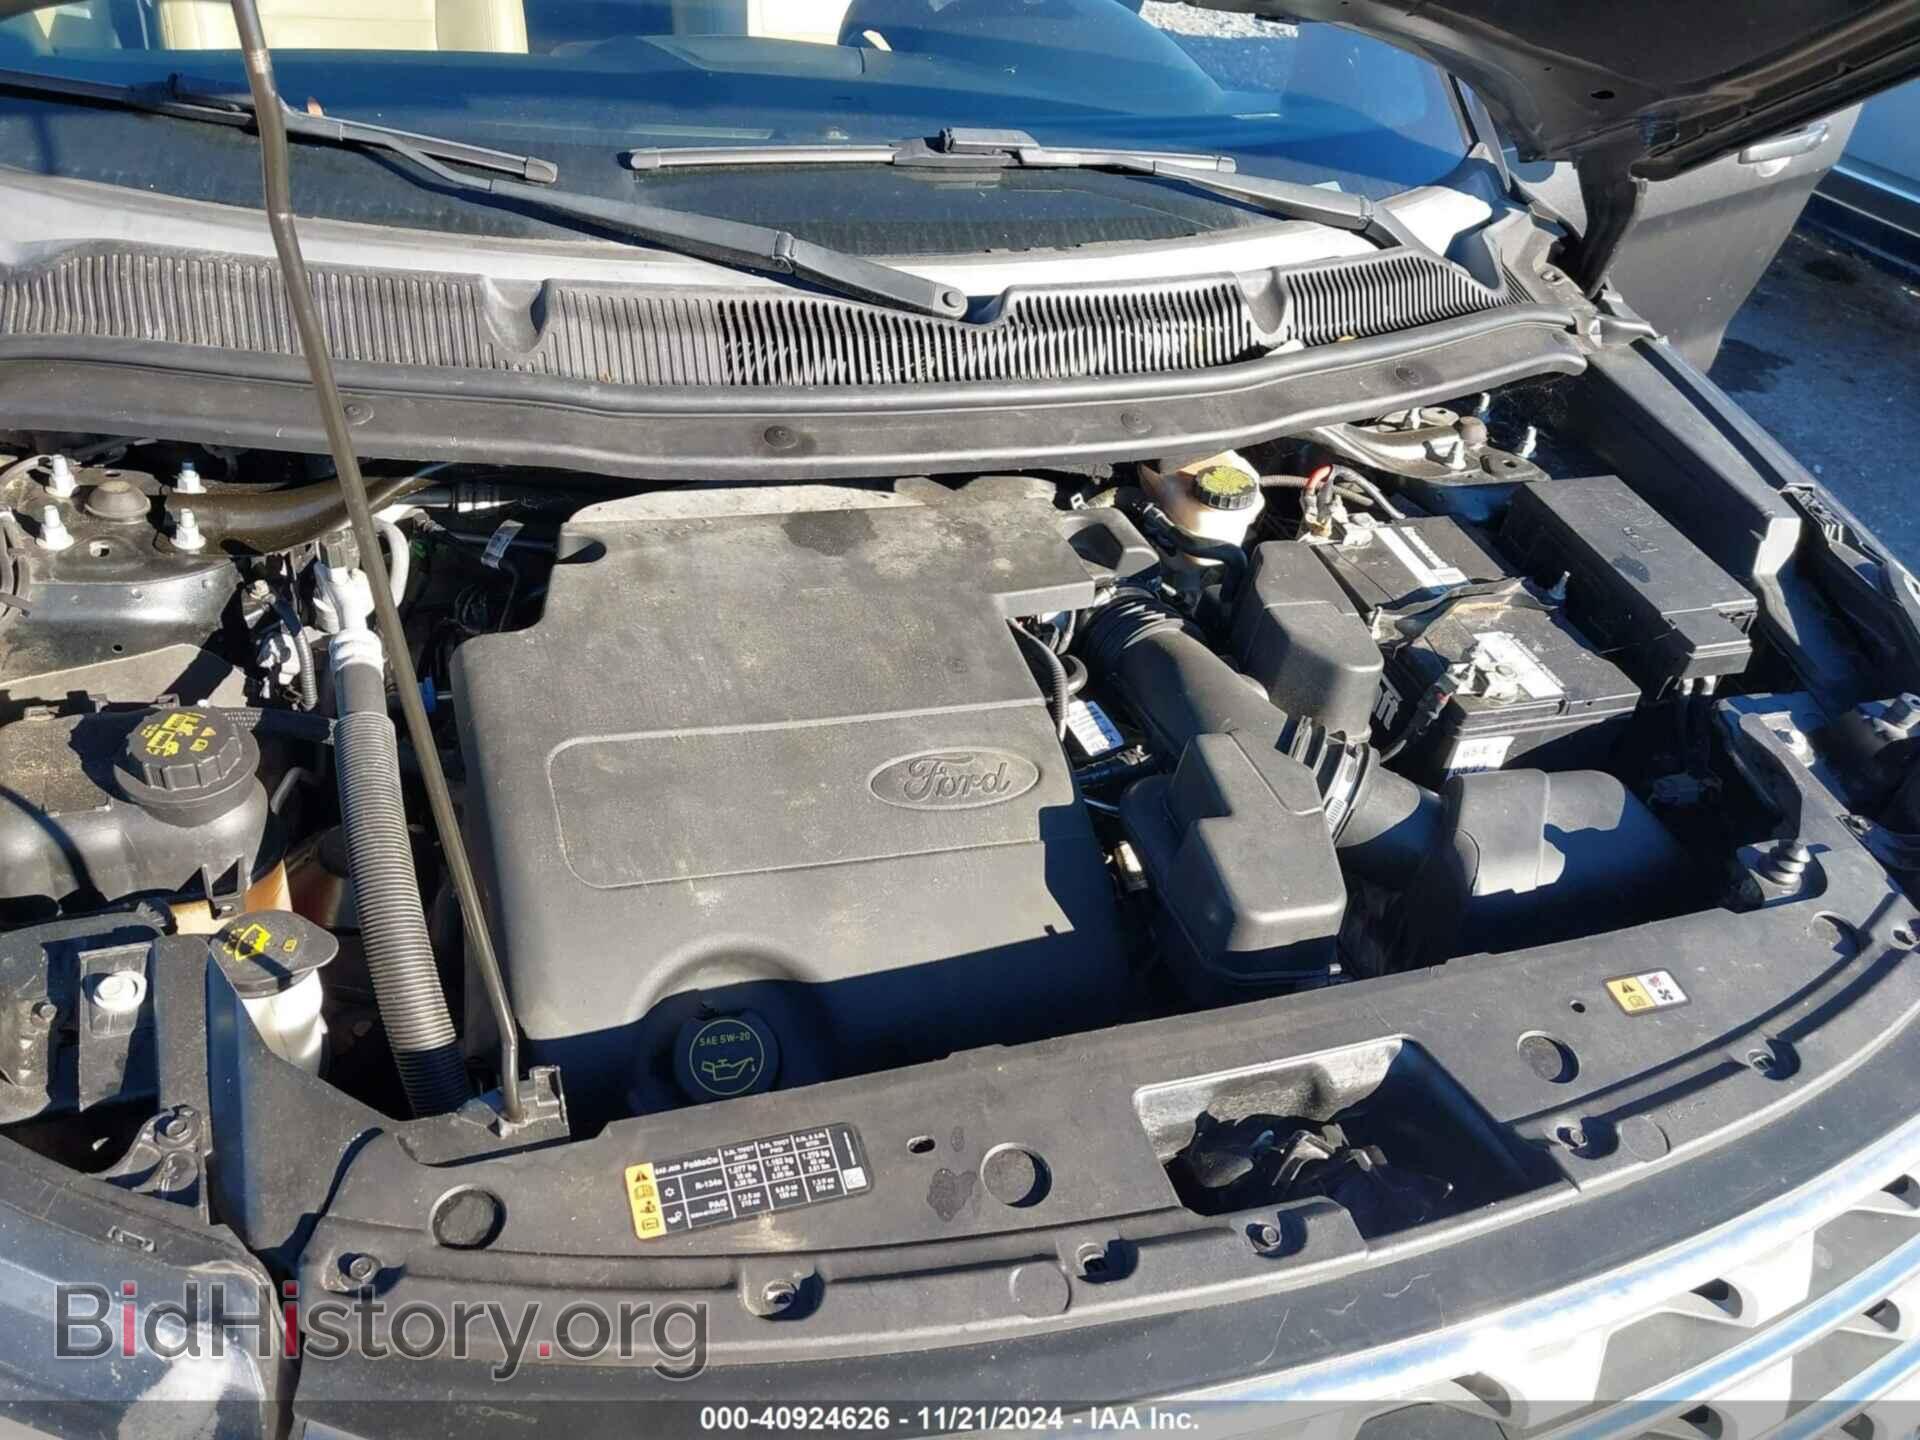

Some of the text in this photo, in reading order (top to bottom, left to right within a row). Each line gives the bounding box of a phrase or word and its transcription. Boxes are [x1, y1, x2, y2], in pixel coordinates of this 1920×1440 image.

[904, 755, 1010, 801] Ford
[700, 1032, 750, 1046] SAE 5W-20
